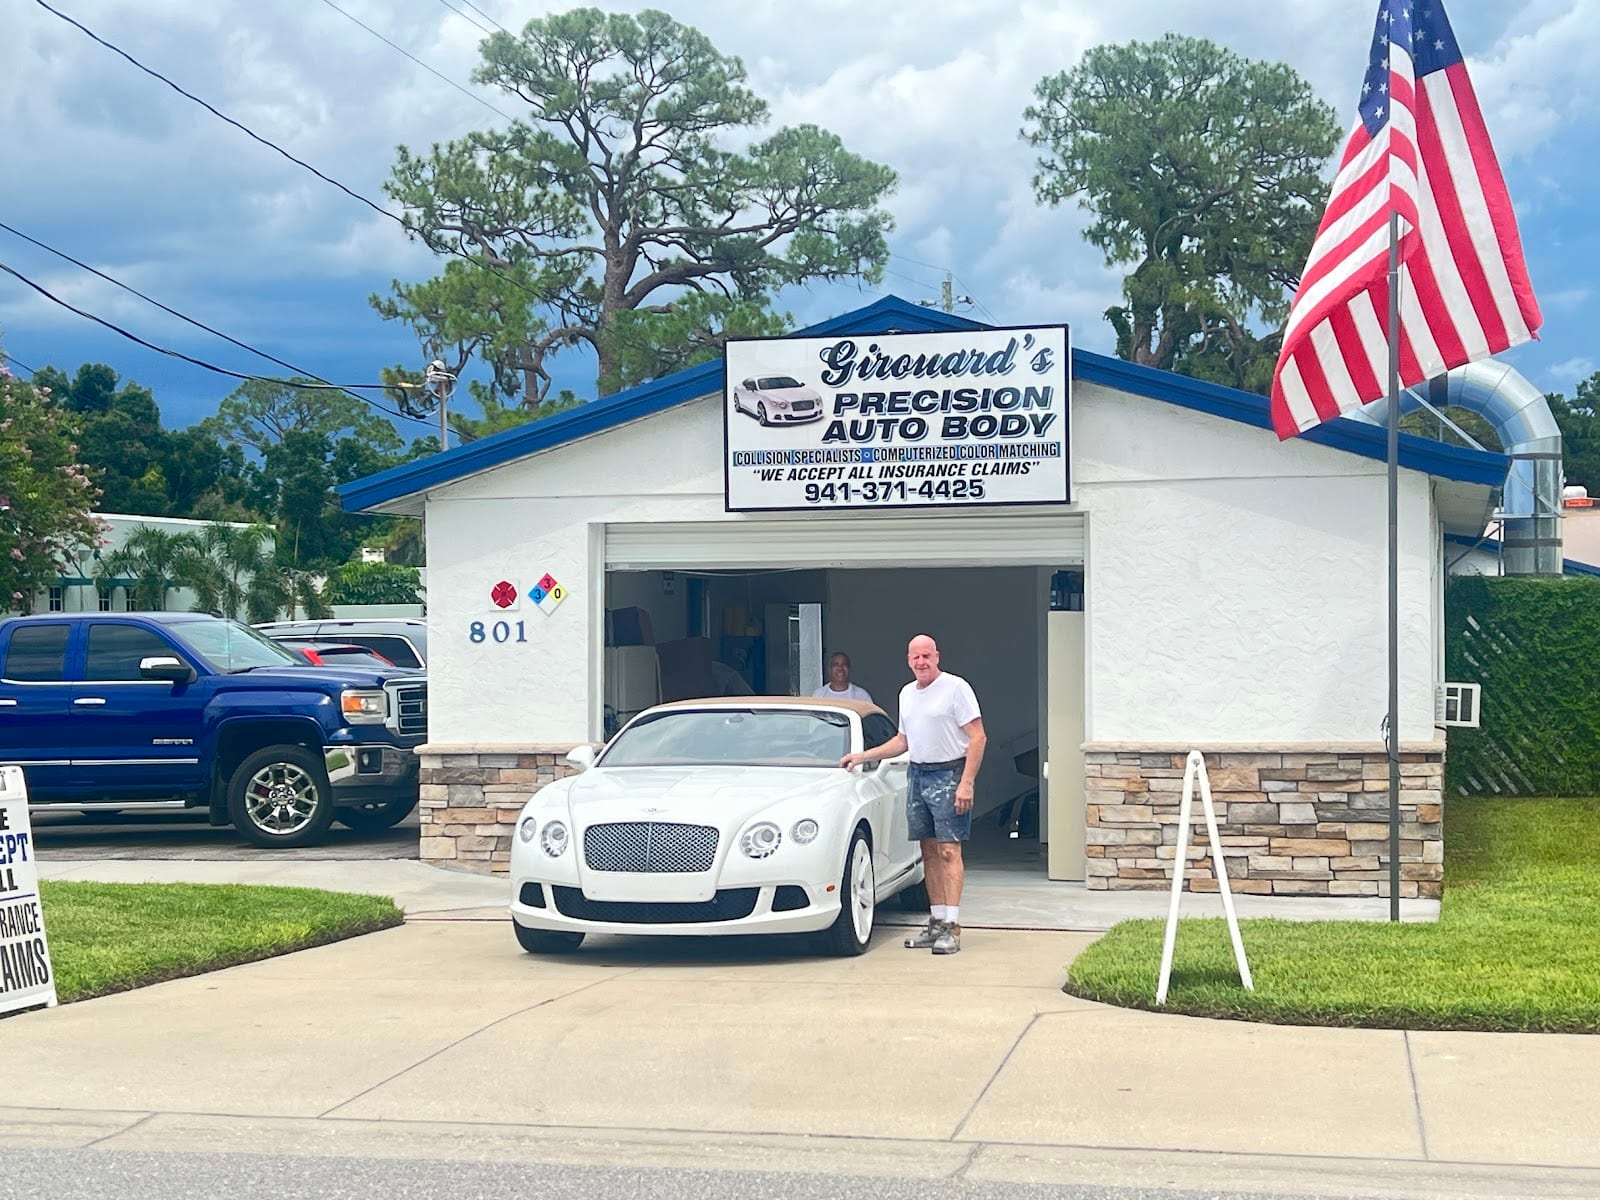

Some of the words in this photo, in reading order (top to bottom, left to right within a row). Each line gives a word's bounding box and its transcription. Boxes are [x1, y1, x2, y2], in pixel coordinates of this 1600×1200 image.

[819, 333, 1054, 388] Girouard's
[833, 386, 1054, 416] PRECISION
[821, 417, 929, 444] AUTO
[941, 412, 1058, 439] BODY
[736, 450, 791, 466] COLLISION
[794, 448, 861, 464] SPECIALISTS
[873, 445, 956, 462] COMPUTERIZED
[959, 444, 995, 460] COLOR
[999, 442, 1057, 458] MATCHING
[787, 466, 845, 481] ACCEPT
[848, 465, 874, 480] ALL
[878, 462, 968, 479] INSURANCE
[804, 478, 985, 503] 941-371-4425
[535, 589, 542, 600] 3
[554, 588, 561, 599] 0
[543, 578, 551, 589] 3
[469, 620, 528, 643] 801
[0, 938, 49, 993] AIMS
